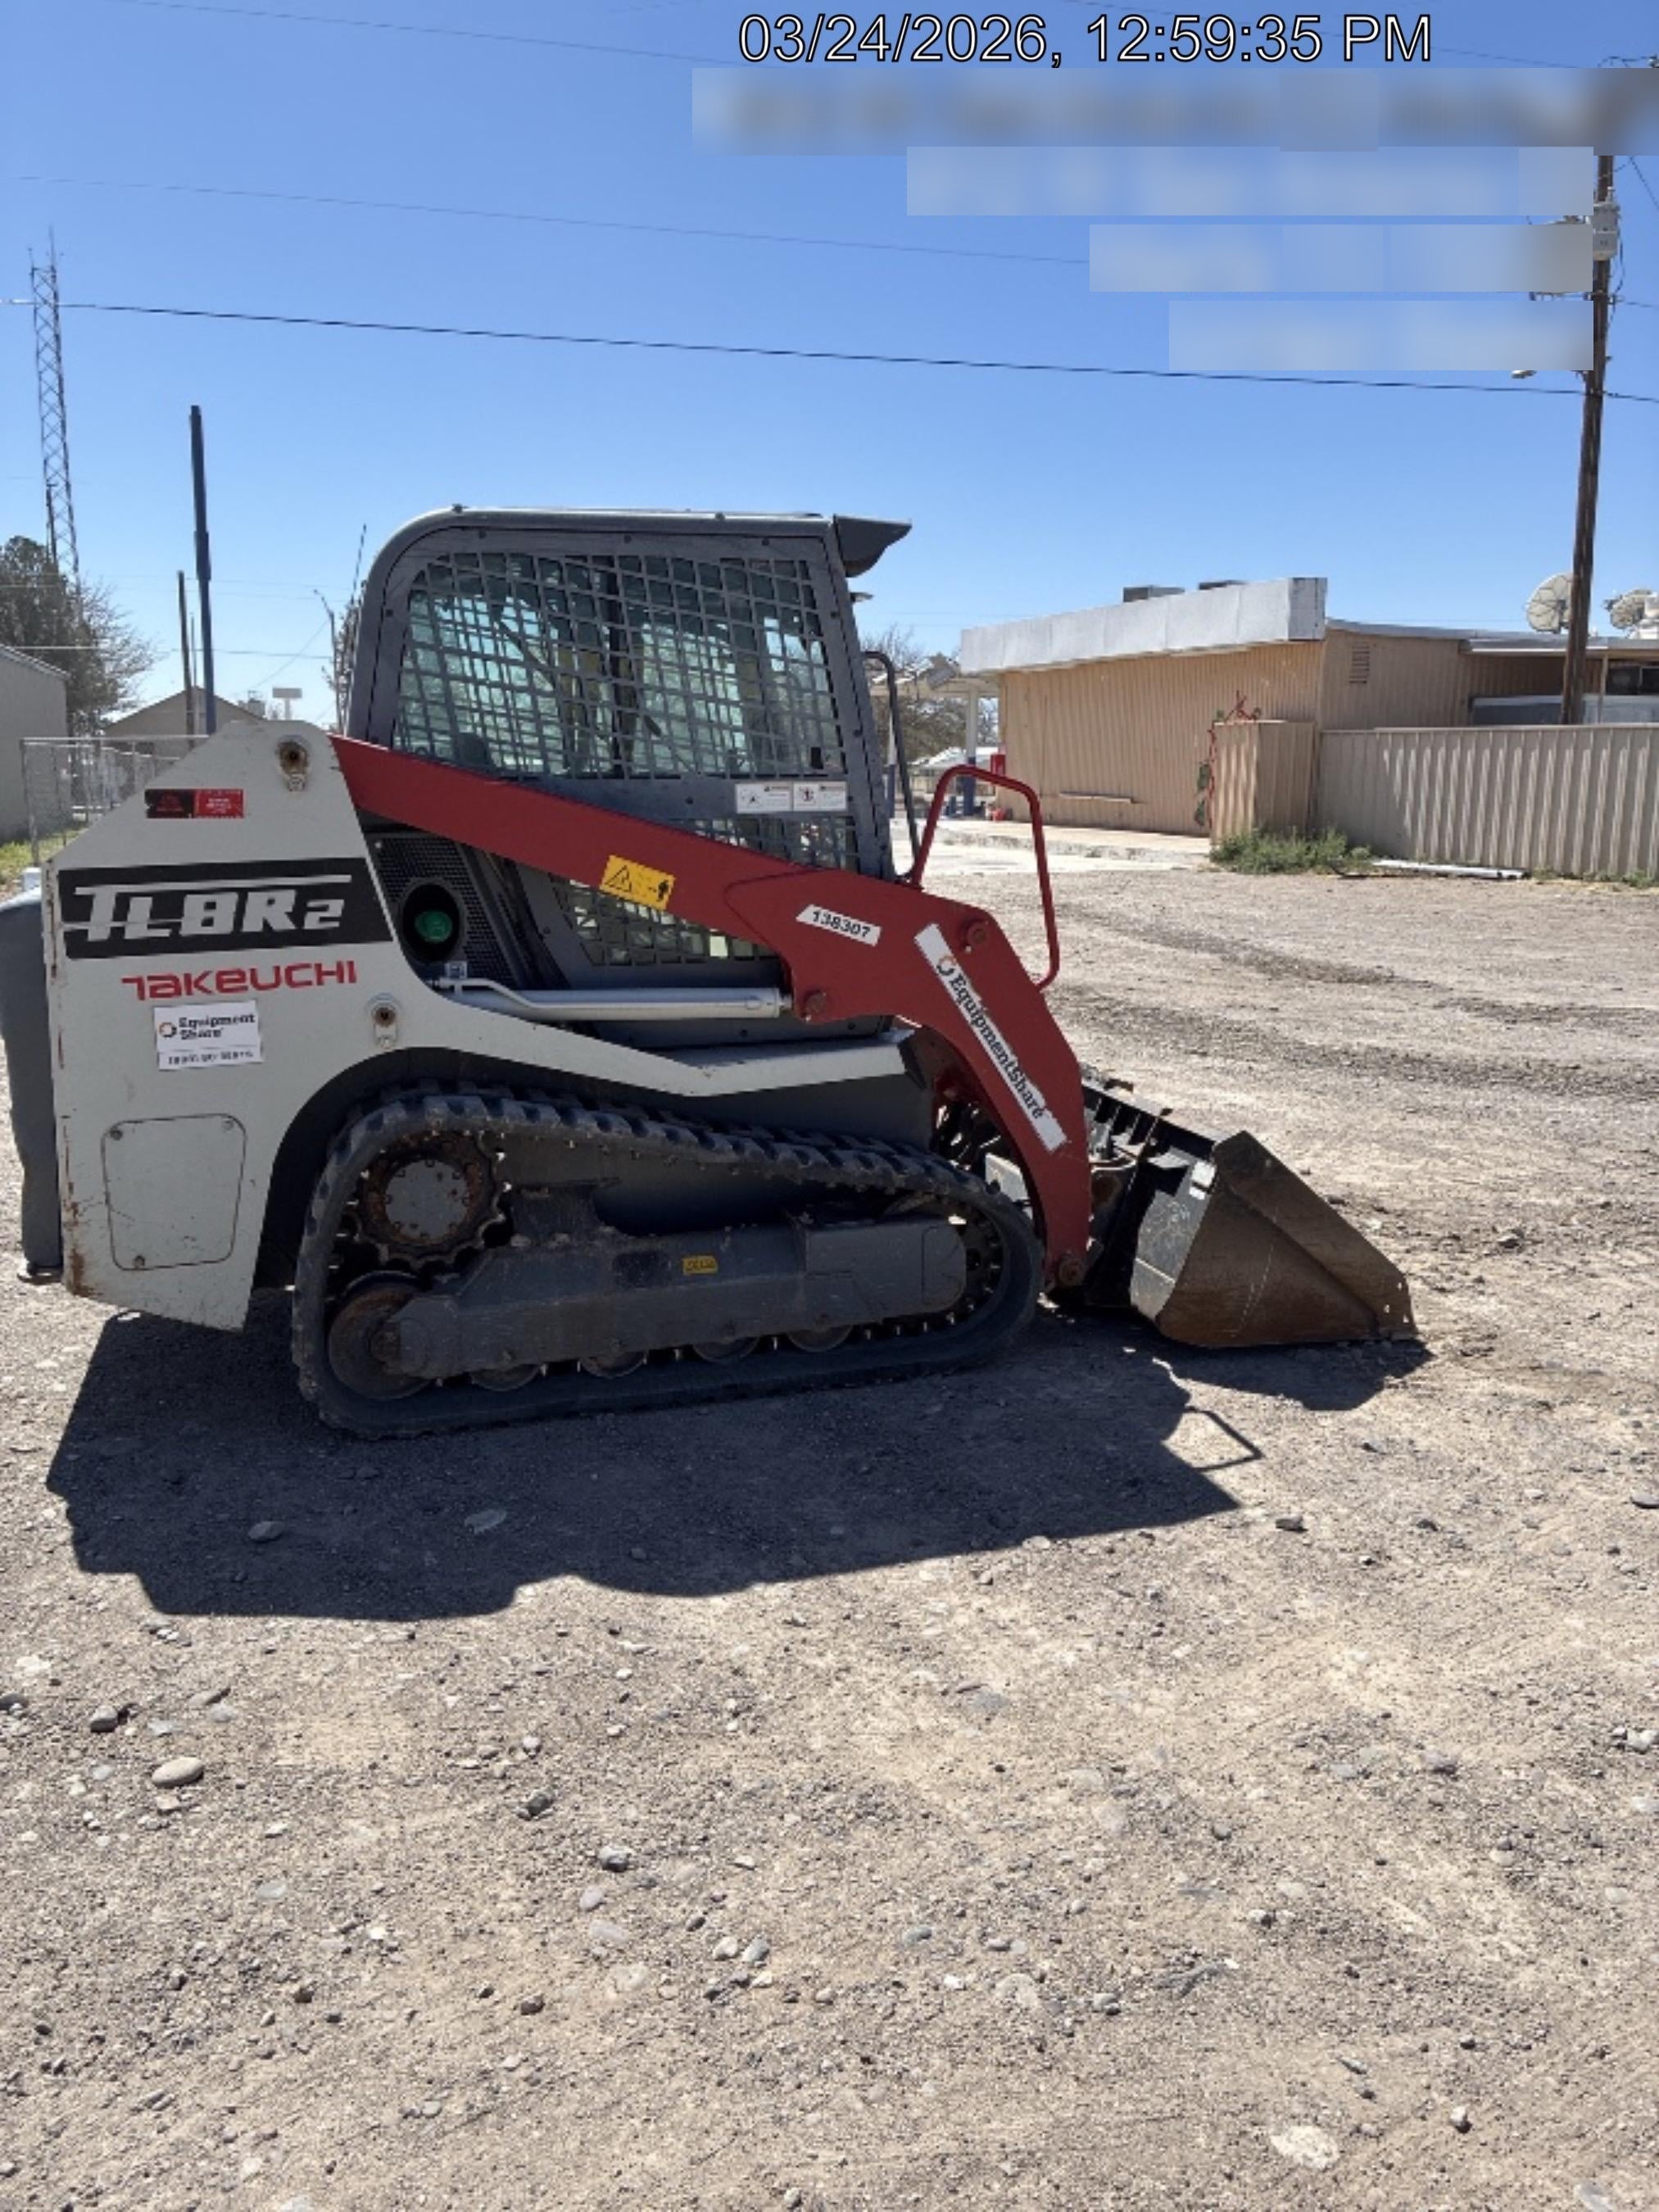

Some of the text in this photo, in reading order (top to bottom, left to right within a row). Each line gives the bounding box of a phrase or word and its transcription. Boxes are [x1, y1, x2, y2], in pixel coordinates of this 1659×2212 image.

[812, 909, 872, 938] 138307
[178, 1013, 256, 1031] Equipment
[179, 1028, 223, 1040] Share
[949, 974, 1044, 1120] EquipmentShare
